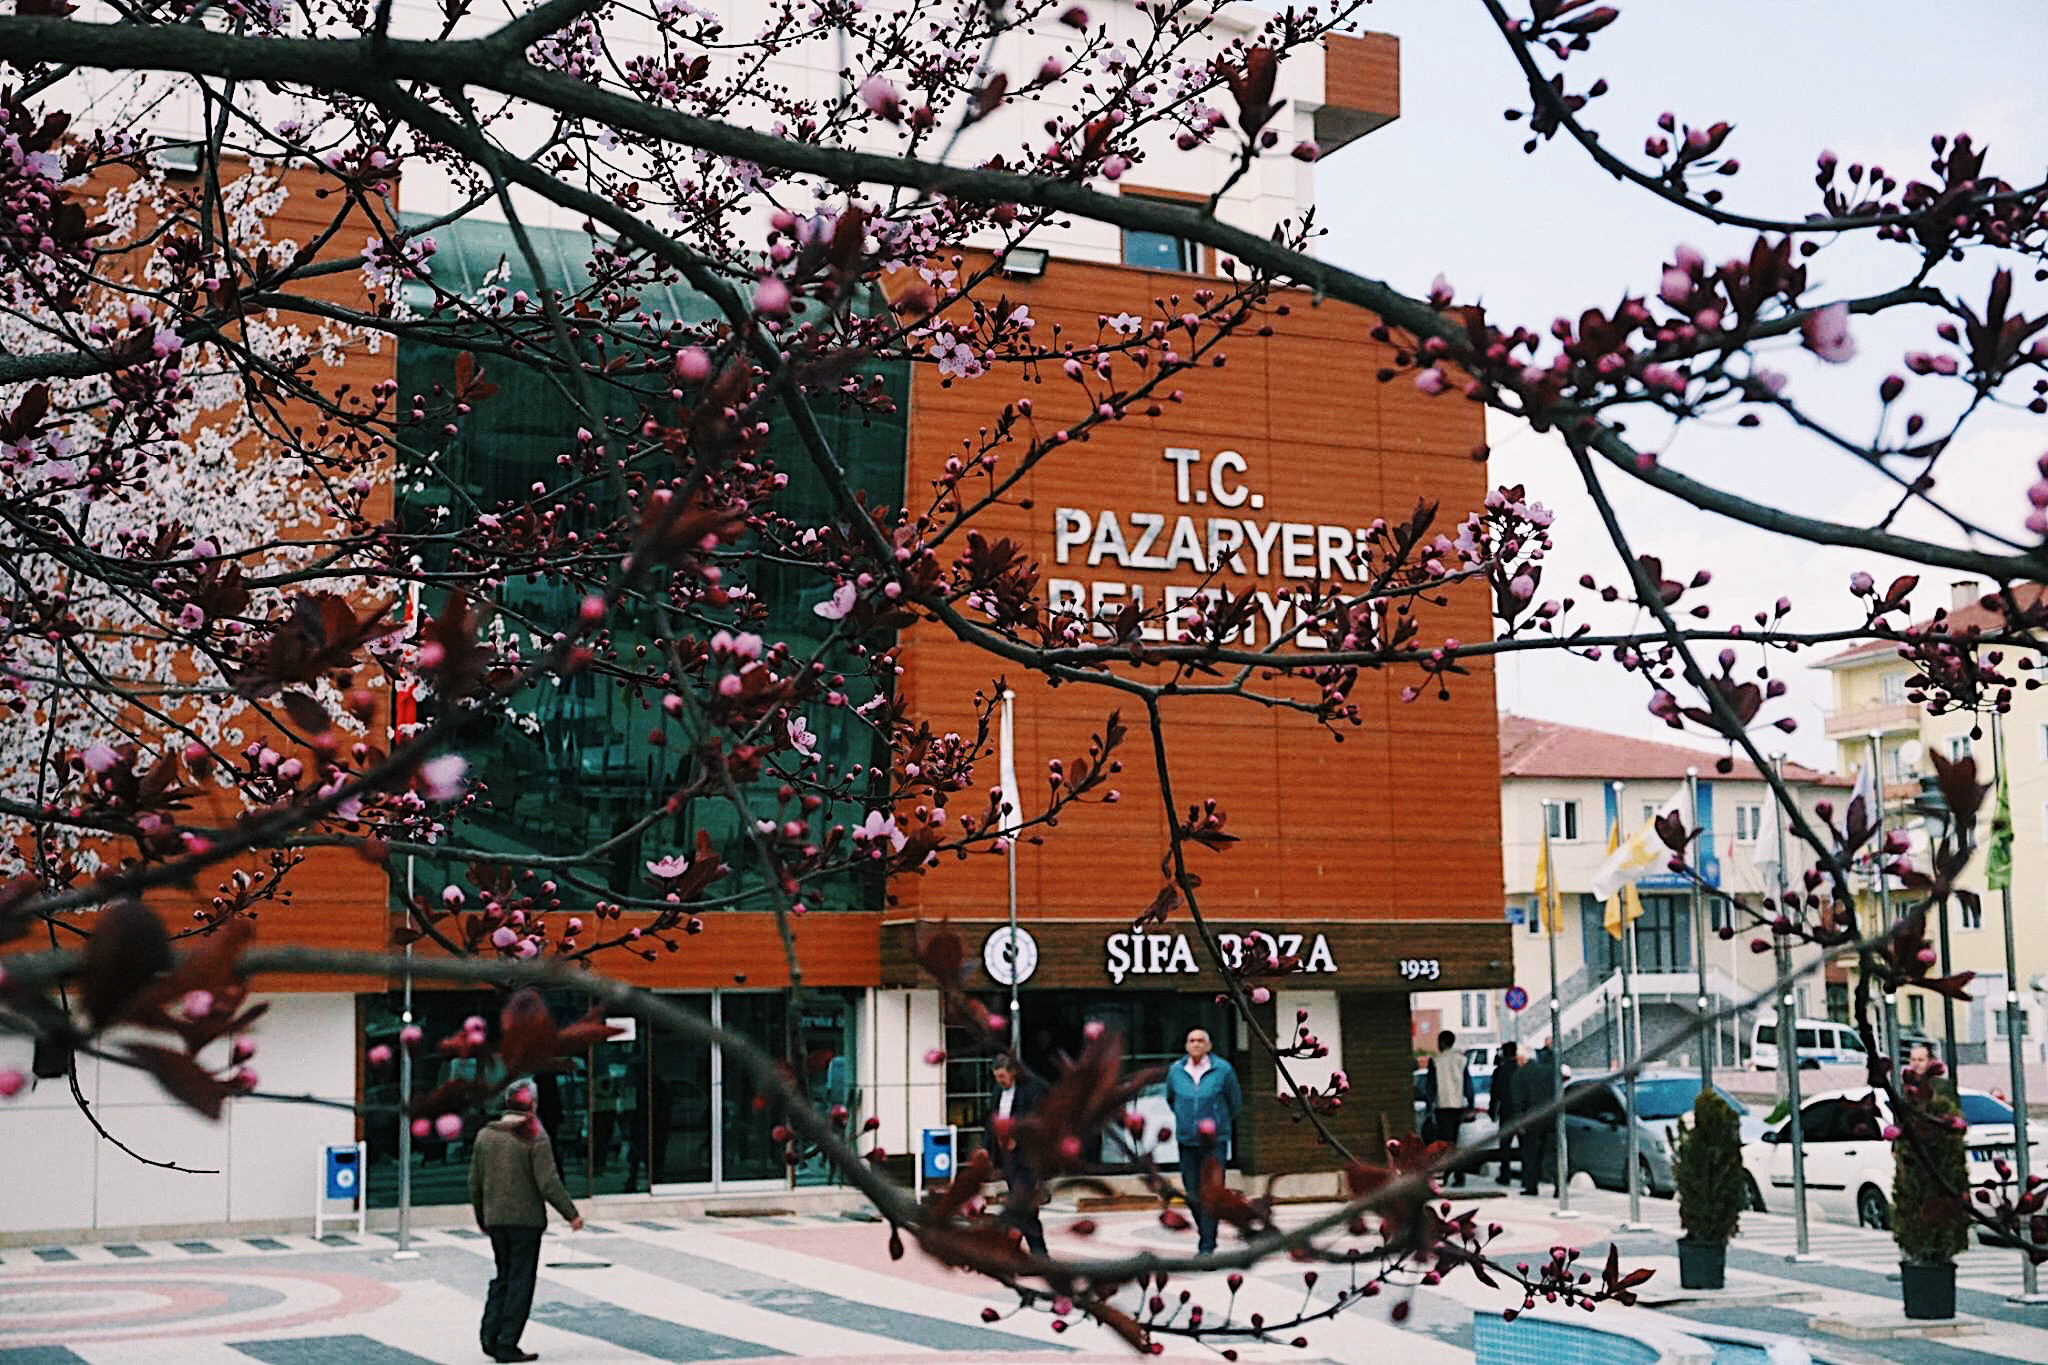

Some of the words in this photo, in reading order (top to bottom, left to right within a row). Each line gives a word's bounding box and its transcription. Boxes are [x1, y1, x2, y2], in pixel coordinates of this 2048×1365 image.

[1164, 447, 1264, 508] T.C.
[1055, 507, 1369, 582] PAZARYERİ
[1047, 578, 1381, 650] BELEİYE
[1107, 925, 1200, 984] ŞİFA
[1400, 959, 1440, 980] 1923
